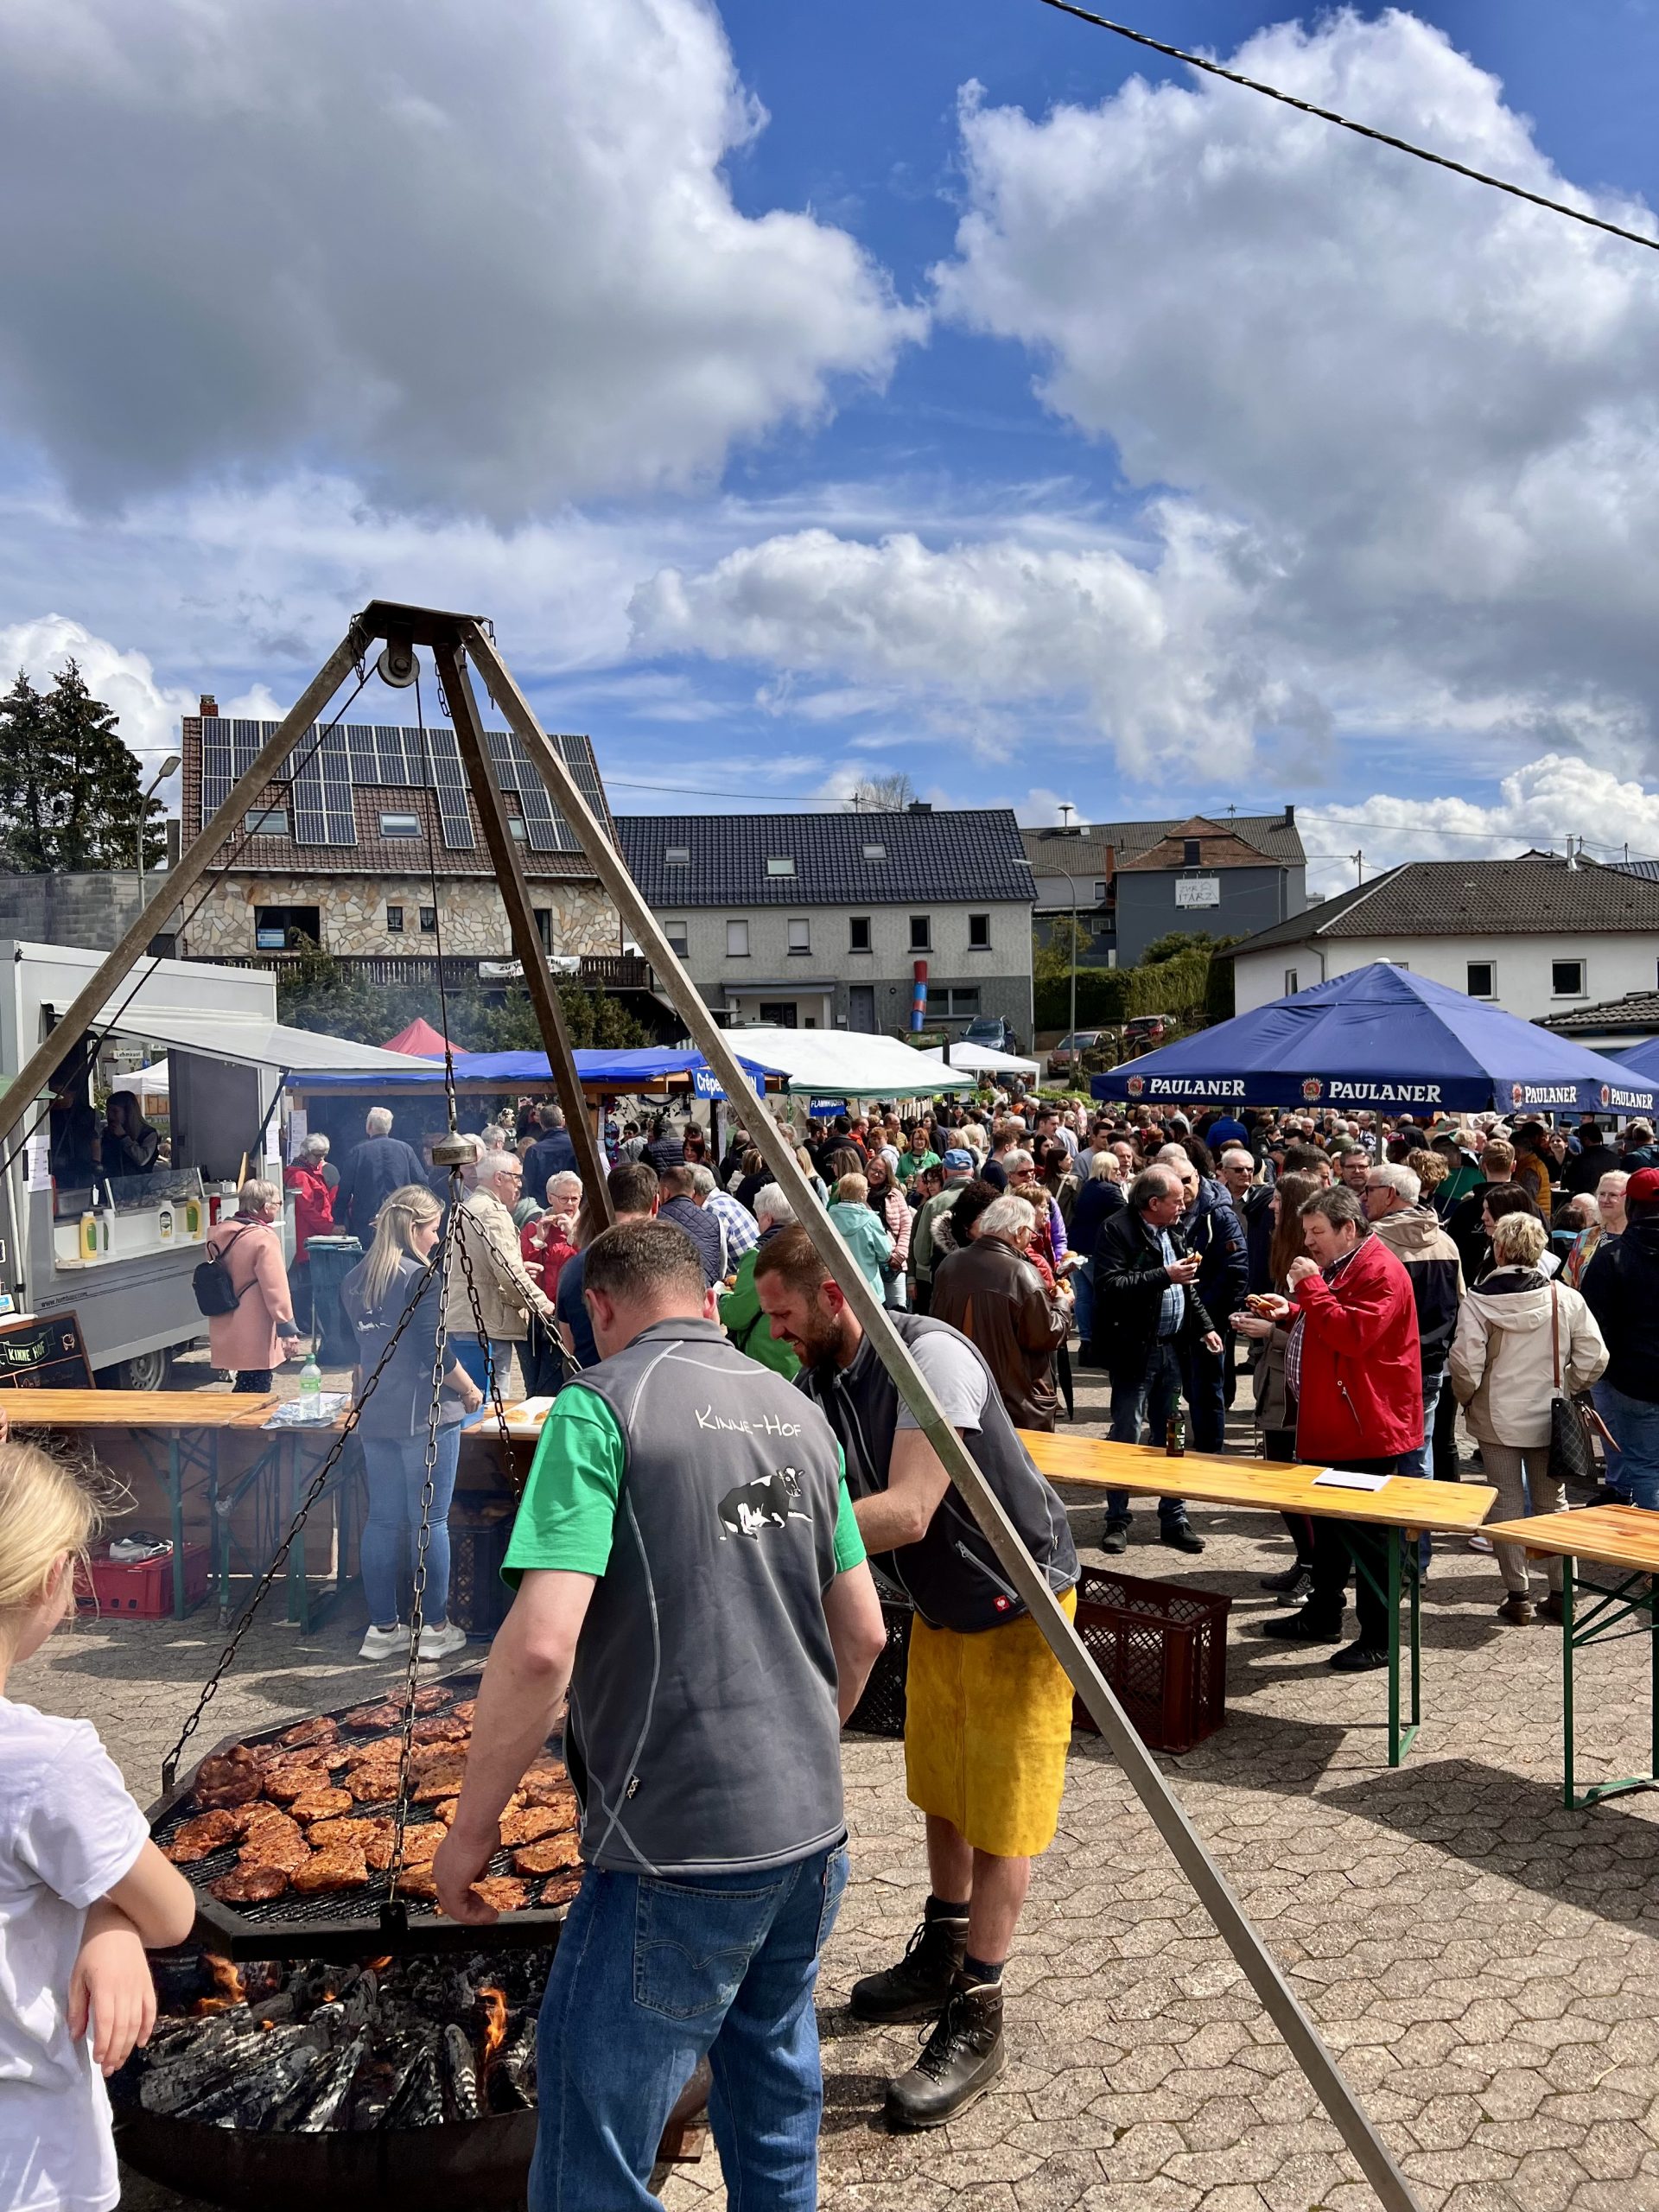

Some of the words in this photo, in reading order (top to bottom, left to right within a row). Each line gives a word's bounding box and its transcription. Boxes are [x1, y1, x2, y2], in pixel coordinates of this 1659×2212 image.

[1149, 1078, 1246, 1096] PAULANER
[1328, 1081, 1442, 1103] PAULANER
[1524, 1085, 1577, 1103] PAULANER
[1611, 1088, 1653, 1110] PAULANER
[8, 1348, 31, 1362] KINNE
[32, 1341, 45, 1359] HOF
